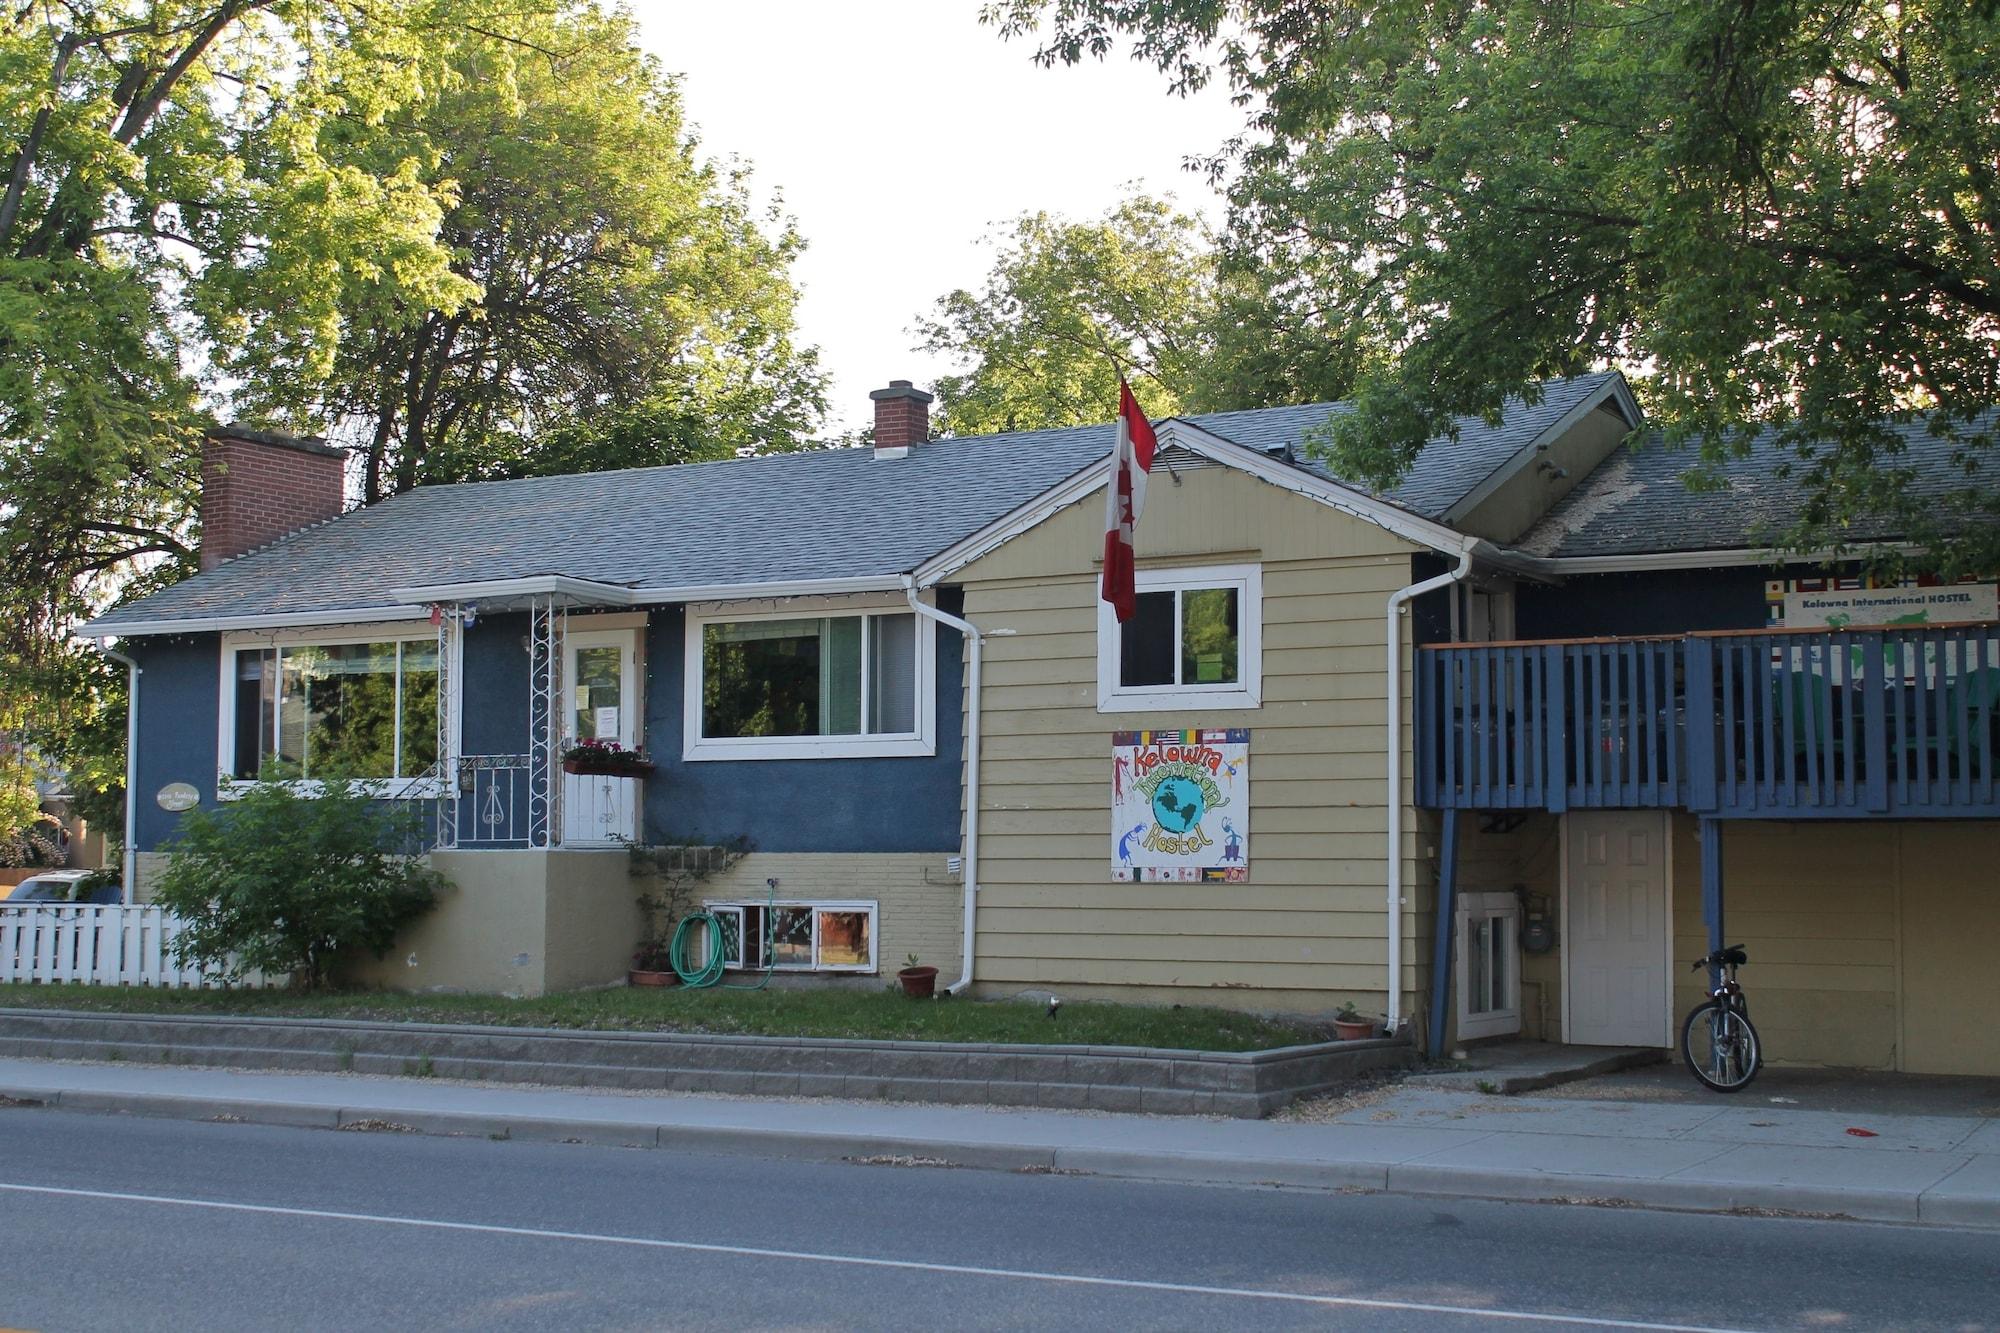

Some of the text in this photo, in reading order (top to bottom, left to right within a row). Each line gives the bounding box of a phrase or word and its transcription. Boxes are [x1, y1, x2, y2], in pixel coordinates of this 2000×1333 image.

[1802, 593, 1972, 609] Kelowna International HOSTEL
[1134, 741, 1222, 776] Kelowna
[1132, 762, 1230, 813] International
[1142, 823, 1213, 855] Hostel
